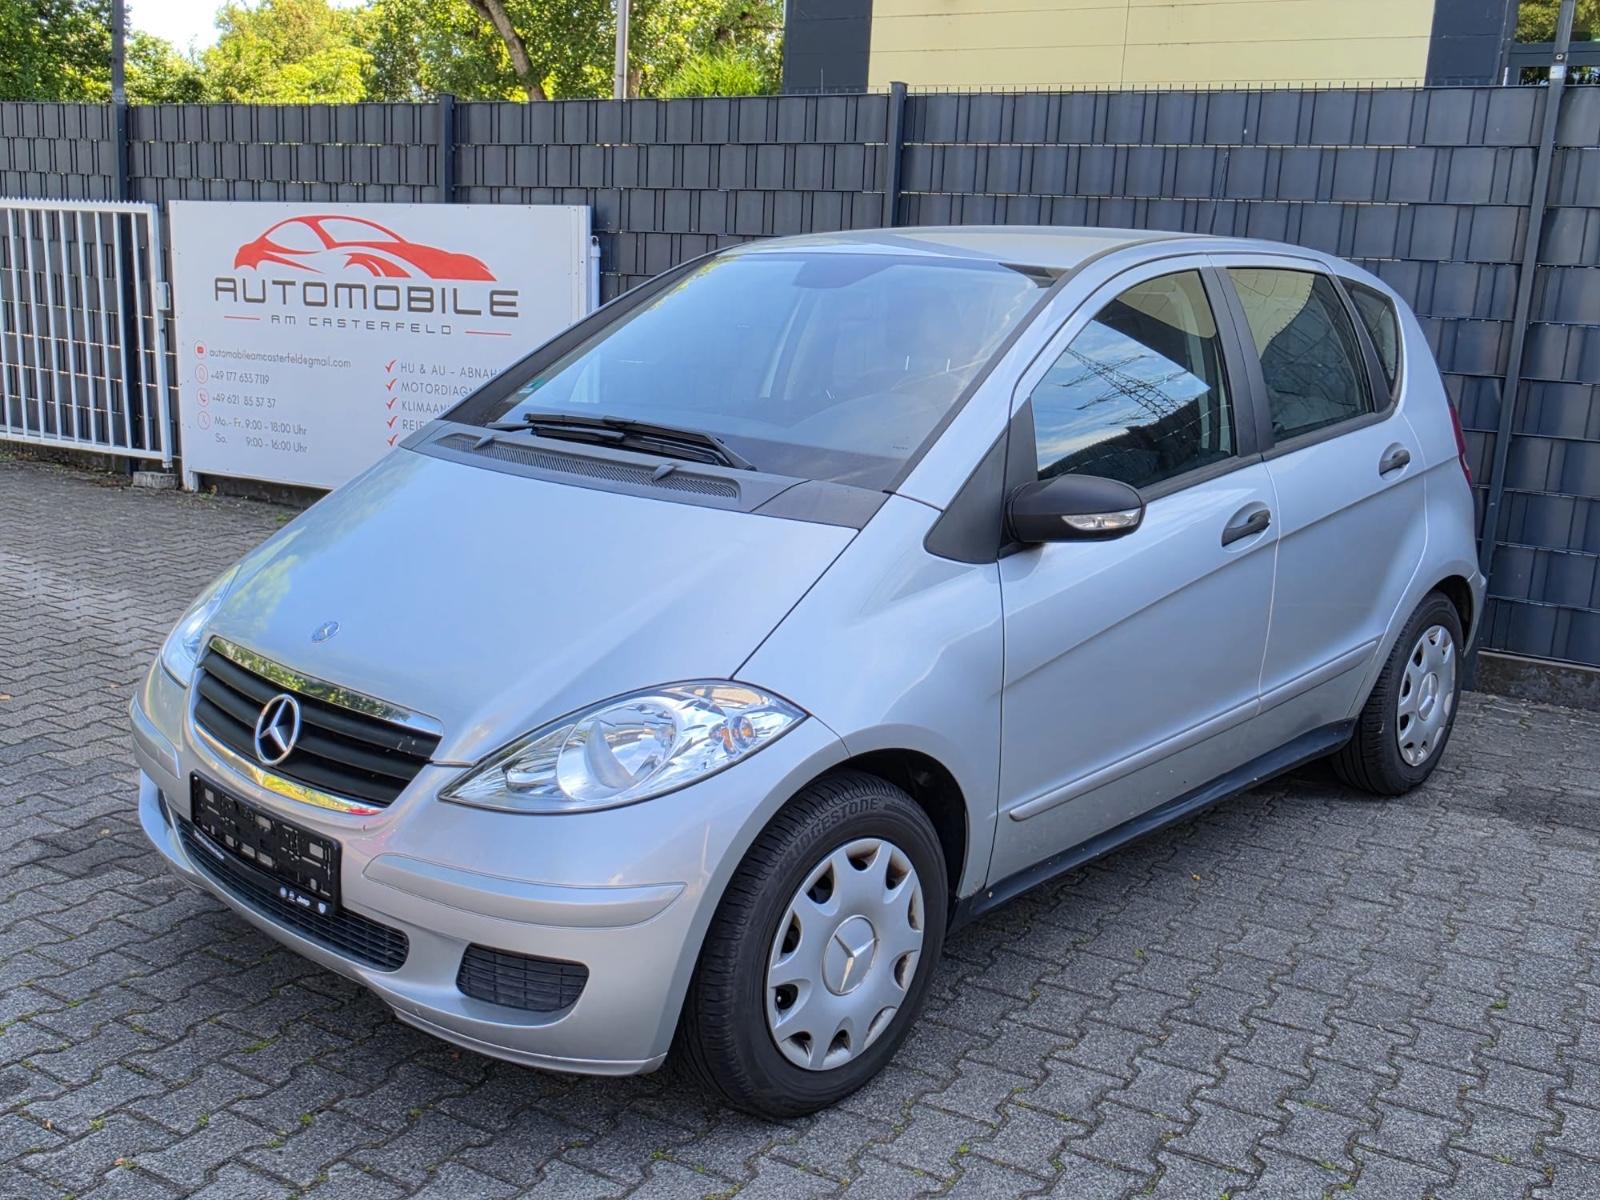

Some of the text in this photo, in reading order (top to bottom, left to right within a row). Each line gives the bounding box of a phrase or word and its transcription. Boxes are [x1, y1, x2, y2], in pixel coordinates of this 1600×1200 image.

[214, 276, 520, 318] AUTOMOBILE
[271, 314, 452, 336] AM CASTERFELD
[211, 370, 224, 380] +49
[226, 371, 237, 382] 177
[254, 373, 270, 385] 7119
[400, 360, 415, 374] HU
[420, 362, 426, 374] &
[431, 363, 446, 377] AU
[459, 366, 502, 380] ABNAH
[400, 381, 473, 397] MOTORDIAG
[212, 392, 277, 409] +49 621 85 37 37
[233, 417, 245, 429] Fr.
[244, 418, 263, 431] 9:00
[270, 421, 292, 435] 18:00
[292, 423, 308, 436] Uhr
[246, 436, 263, 448] 9:00
[271, 439, 292, 453] 16:00
[293, 441, 308, 454] Uhr
